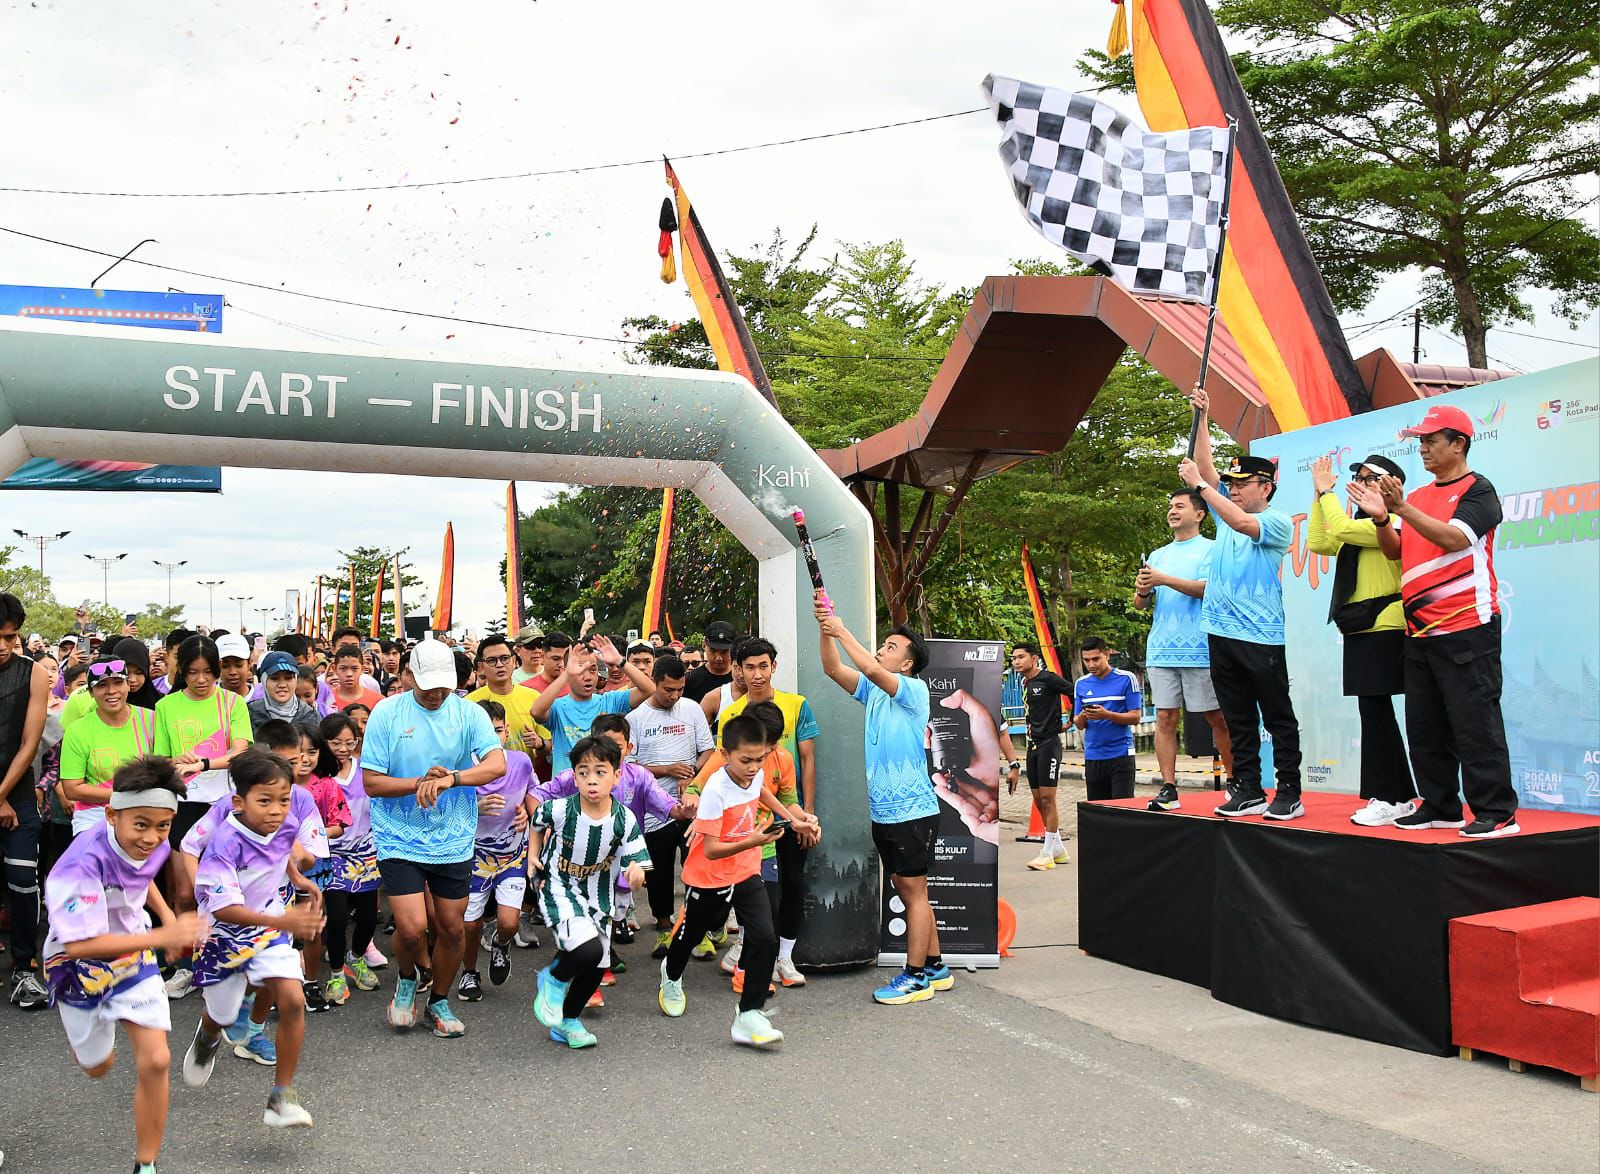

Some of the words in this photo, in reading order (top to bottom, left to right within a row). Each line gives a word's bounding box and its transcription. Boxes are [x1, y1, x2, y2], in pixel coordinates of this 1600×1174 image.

[163, 366, 348, 419] START
[431, 383, 603, 433] FINISH
[1566, 408, 1584, 417] Kota
[1585, 403, 1600, 413] Pad
[758, 464, 812, 488] Kahf
[928, 678, 957, 690] Kahf
[1049, 757, 1058, 779] 2XU
[1307, 774, 1327, 784] taspen
[1524, 772, 1562, 783] POCARI
[1525, 781, 1560, 792] SWEAT
[945, 846, 968, 854] KULIT
